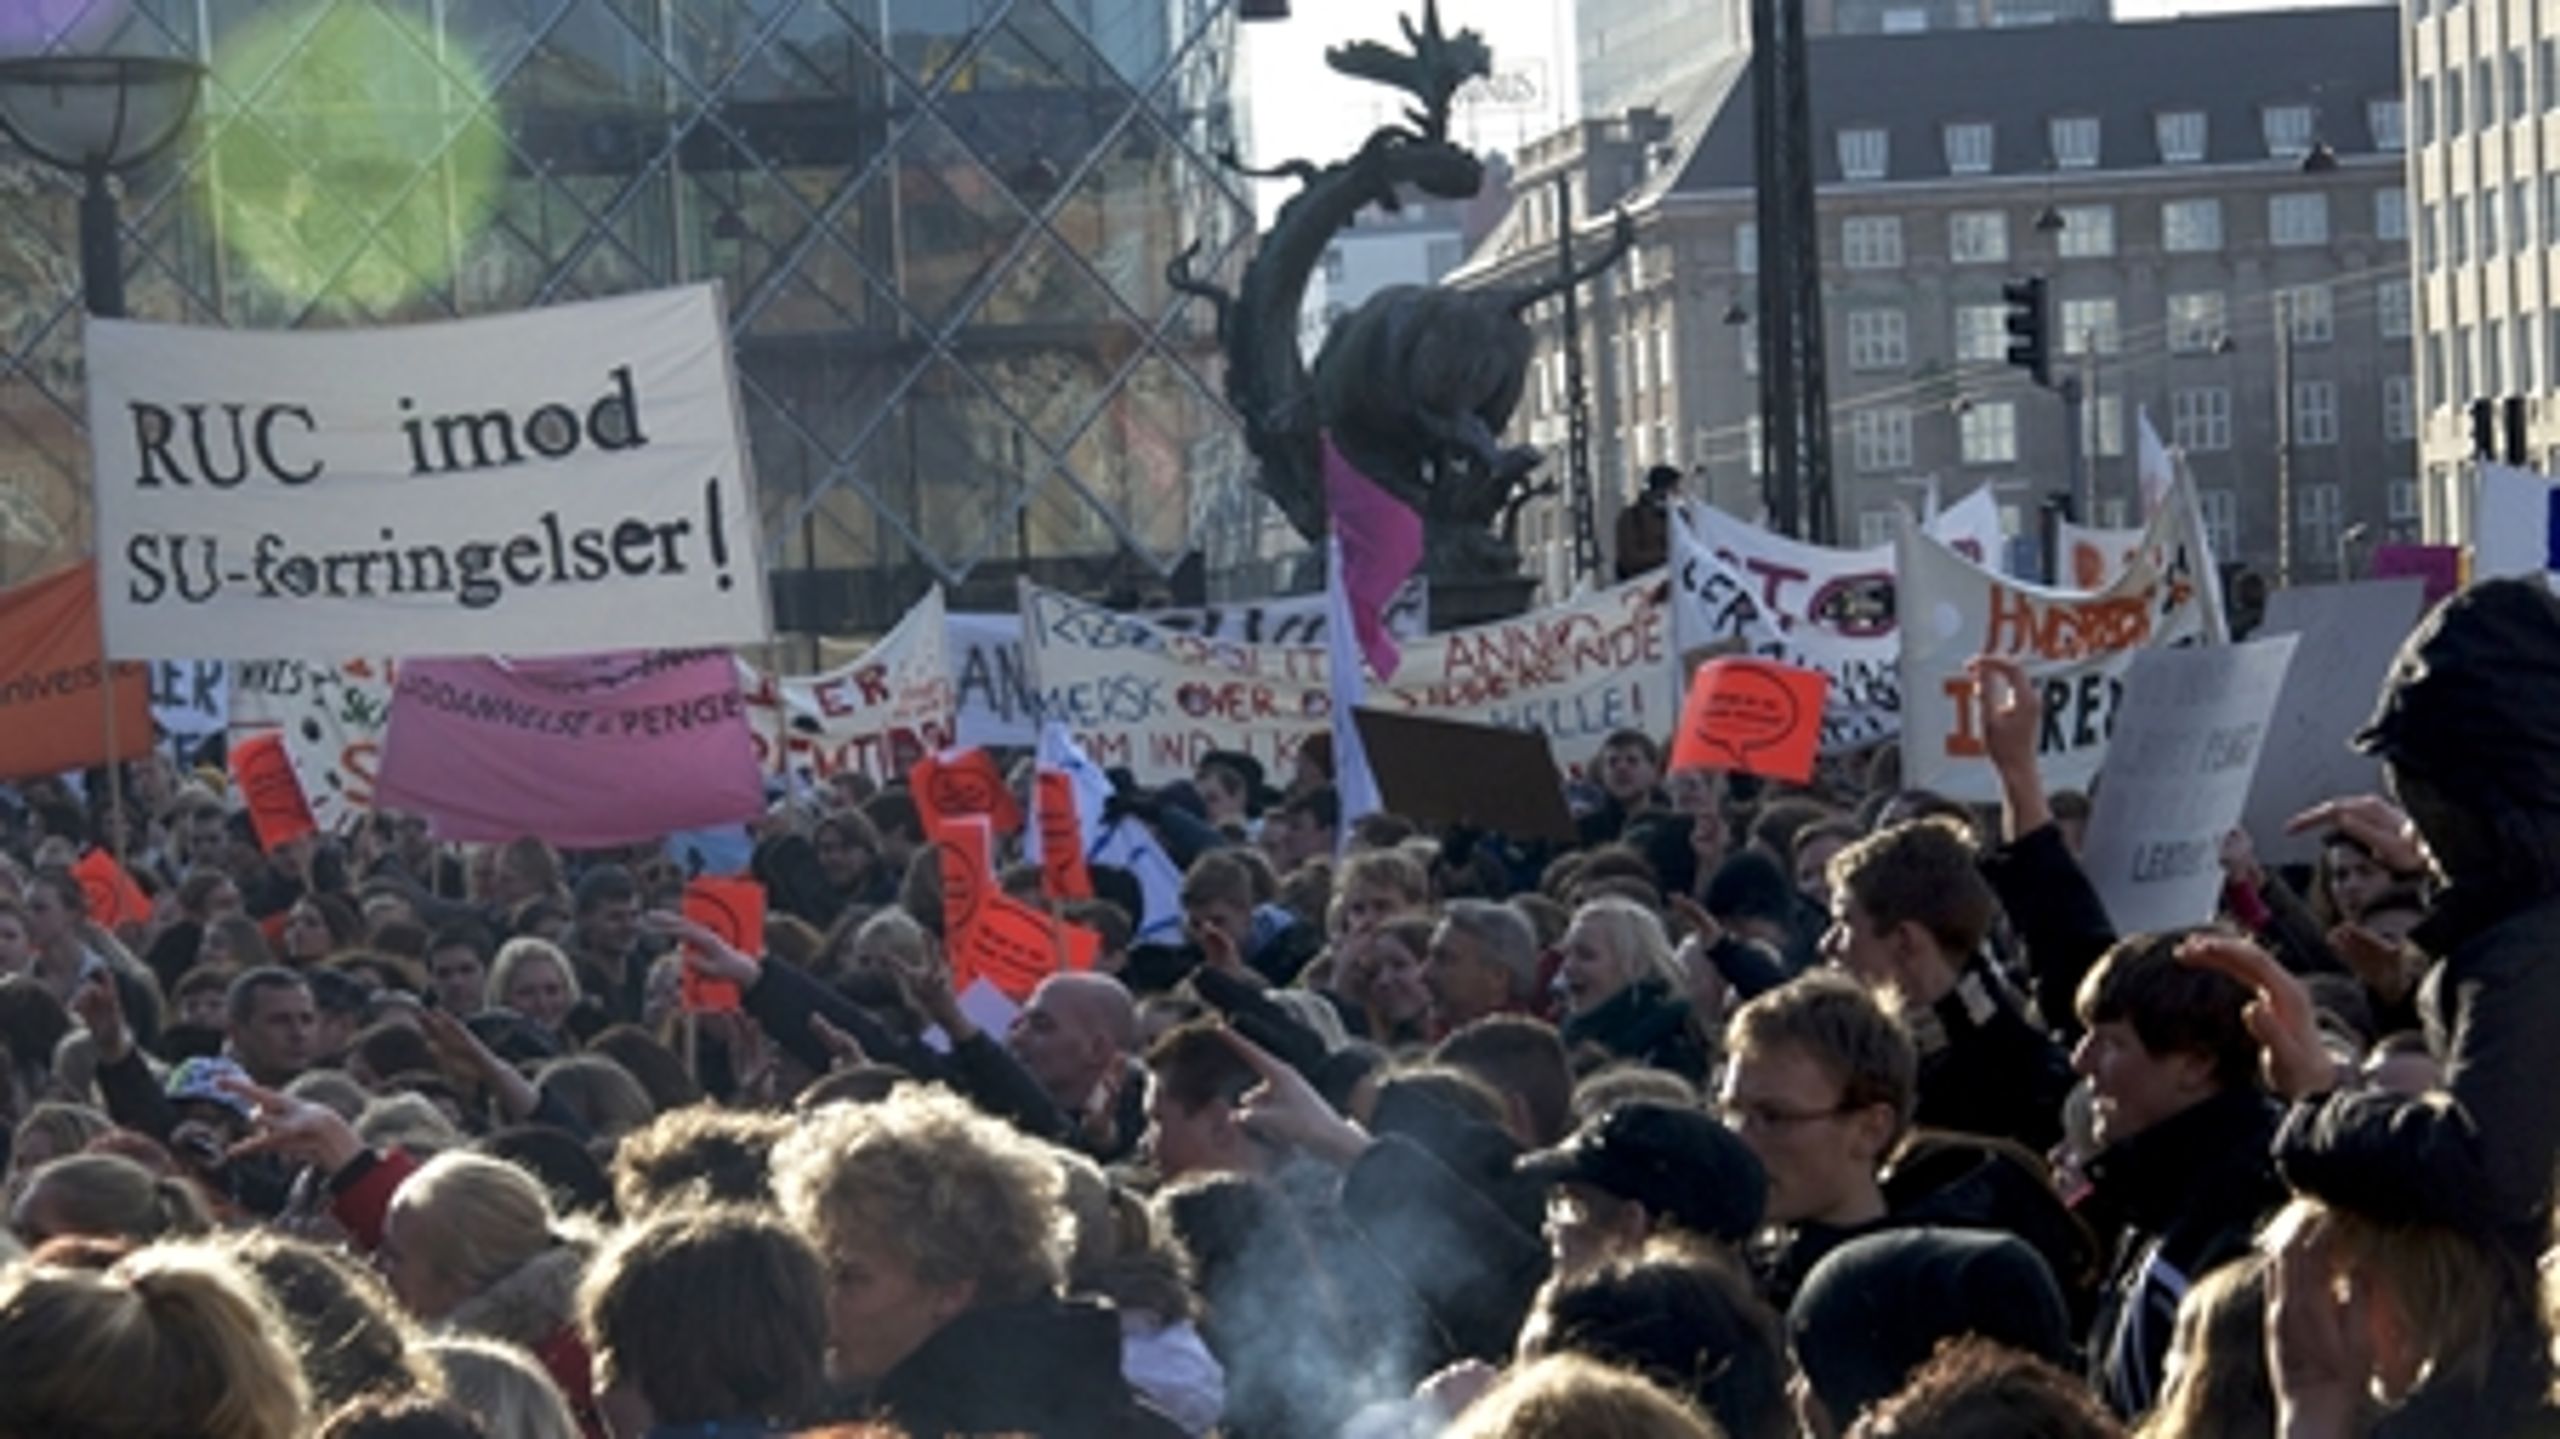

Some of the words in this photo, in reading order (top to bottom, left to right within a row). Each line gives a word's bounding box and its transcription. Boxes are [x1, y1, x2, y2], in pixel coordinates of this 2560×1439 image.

[126, 399, 324, 489] RUC
[399, 364, 650, 476] imod
[126, 476, 734, 610] SU-forringelser!
